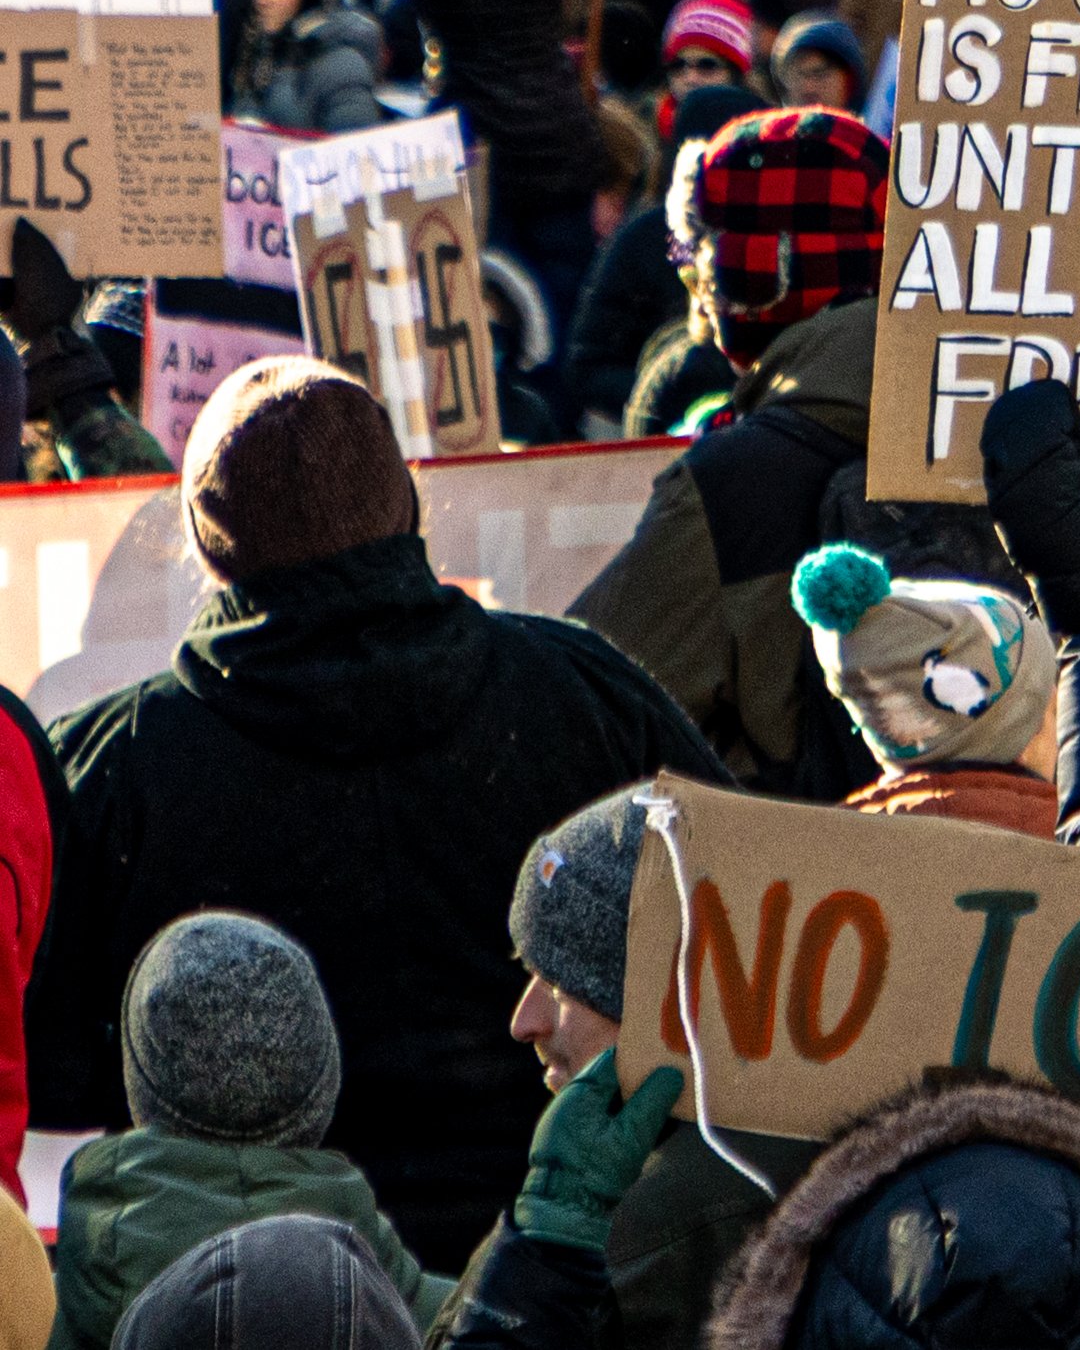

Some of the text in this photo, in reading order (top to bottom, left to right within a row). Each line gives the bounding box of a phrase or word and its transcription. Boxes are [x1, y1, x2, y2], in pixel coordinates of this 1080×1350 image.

[916, 14, 1002, 106] IS
[888, 219, 1075, 317] ALL
[660, 876, 893, 1065] NO
